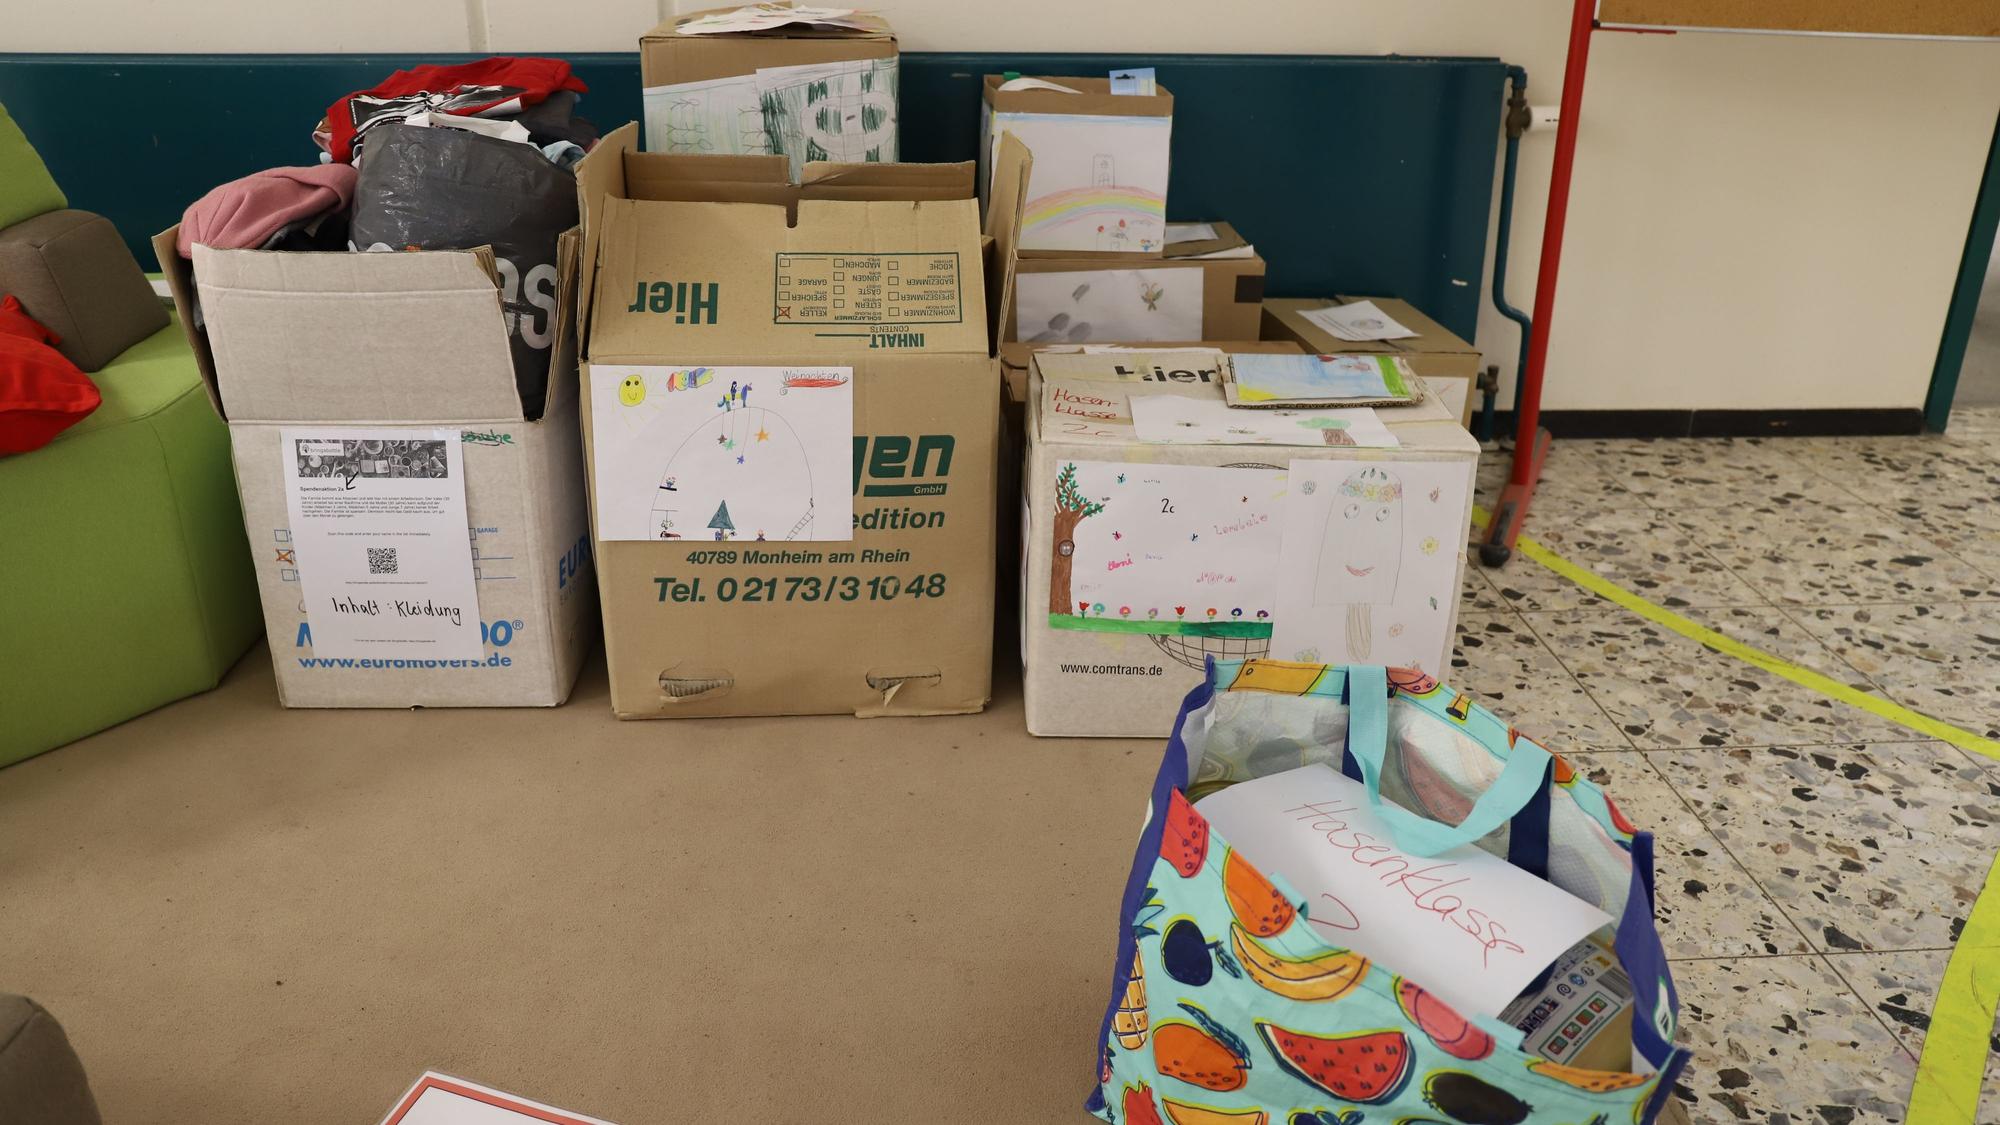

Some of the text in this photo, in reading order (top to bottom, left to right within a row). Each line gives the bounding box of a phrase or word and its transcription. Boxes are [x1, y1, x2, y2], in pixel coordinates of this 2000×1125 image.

[798, 278, 827, 286] GARAGE
[852, 274, 882, 282] JUNGEN
[906, 278, 954, 286] BADEZIMMER
[628, 281, 718, 325] Hier
[900, 293, 955, 301] SPEISEZIMMER
[800, 309, 827, 317] KELLER
[903, 309, 956, 317] WOHNZIMMER
[870, 325, 909, 333] CONTENTS
[869, 333, 925, 348] INHALT
[1114, 365, 1217, 383] Hier
[913, 486, 943, 494] GmbH
[1161, 498, 1175, 514] 2c
[686, 549, 910, 564] 40789 Monheim am Rhein
[654, 577, 706, 602] Tel.
[396, 600, 461, 626] Kleidung
[297, 652, 512, 669] www.euromovers.de
[1060, 663, 1163, 677] www.comtrans.de
